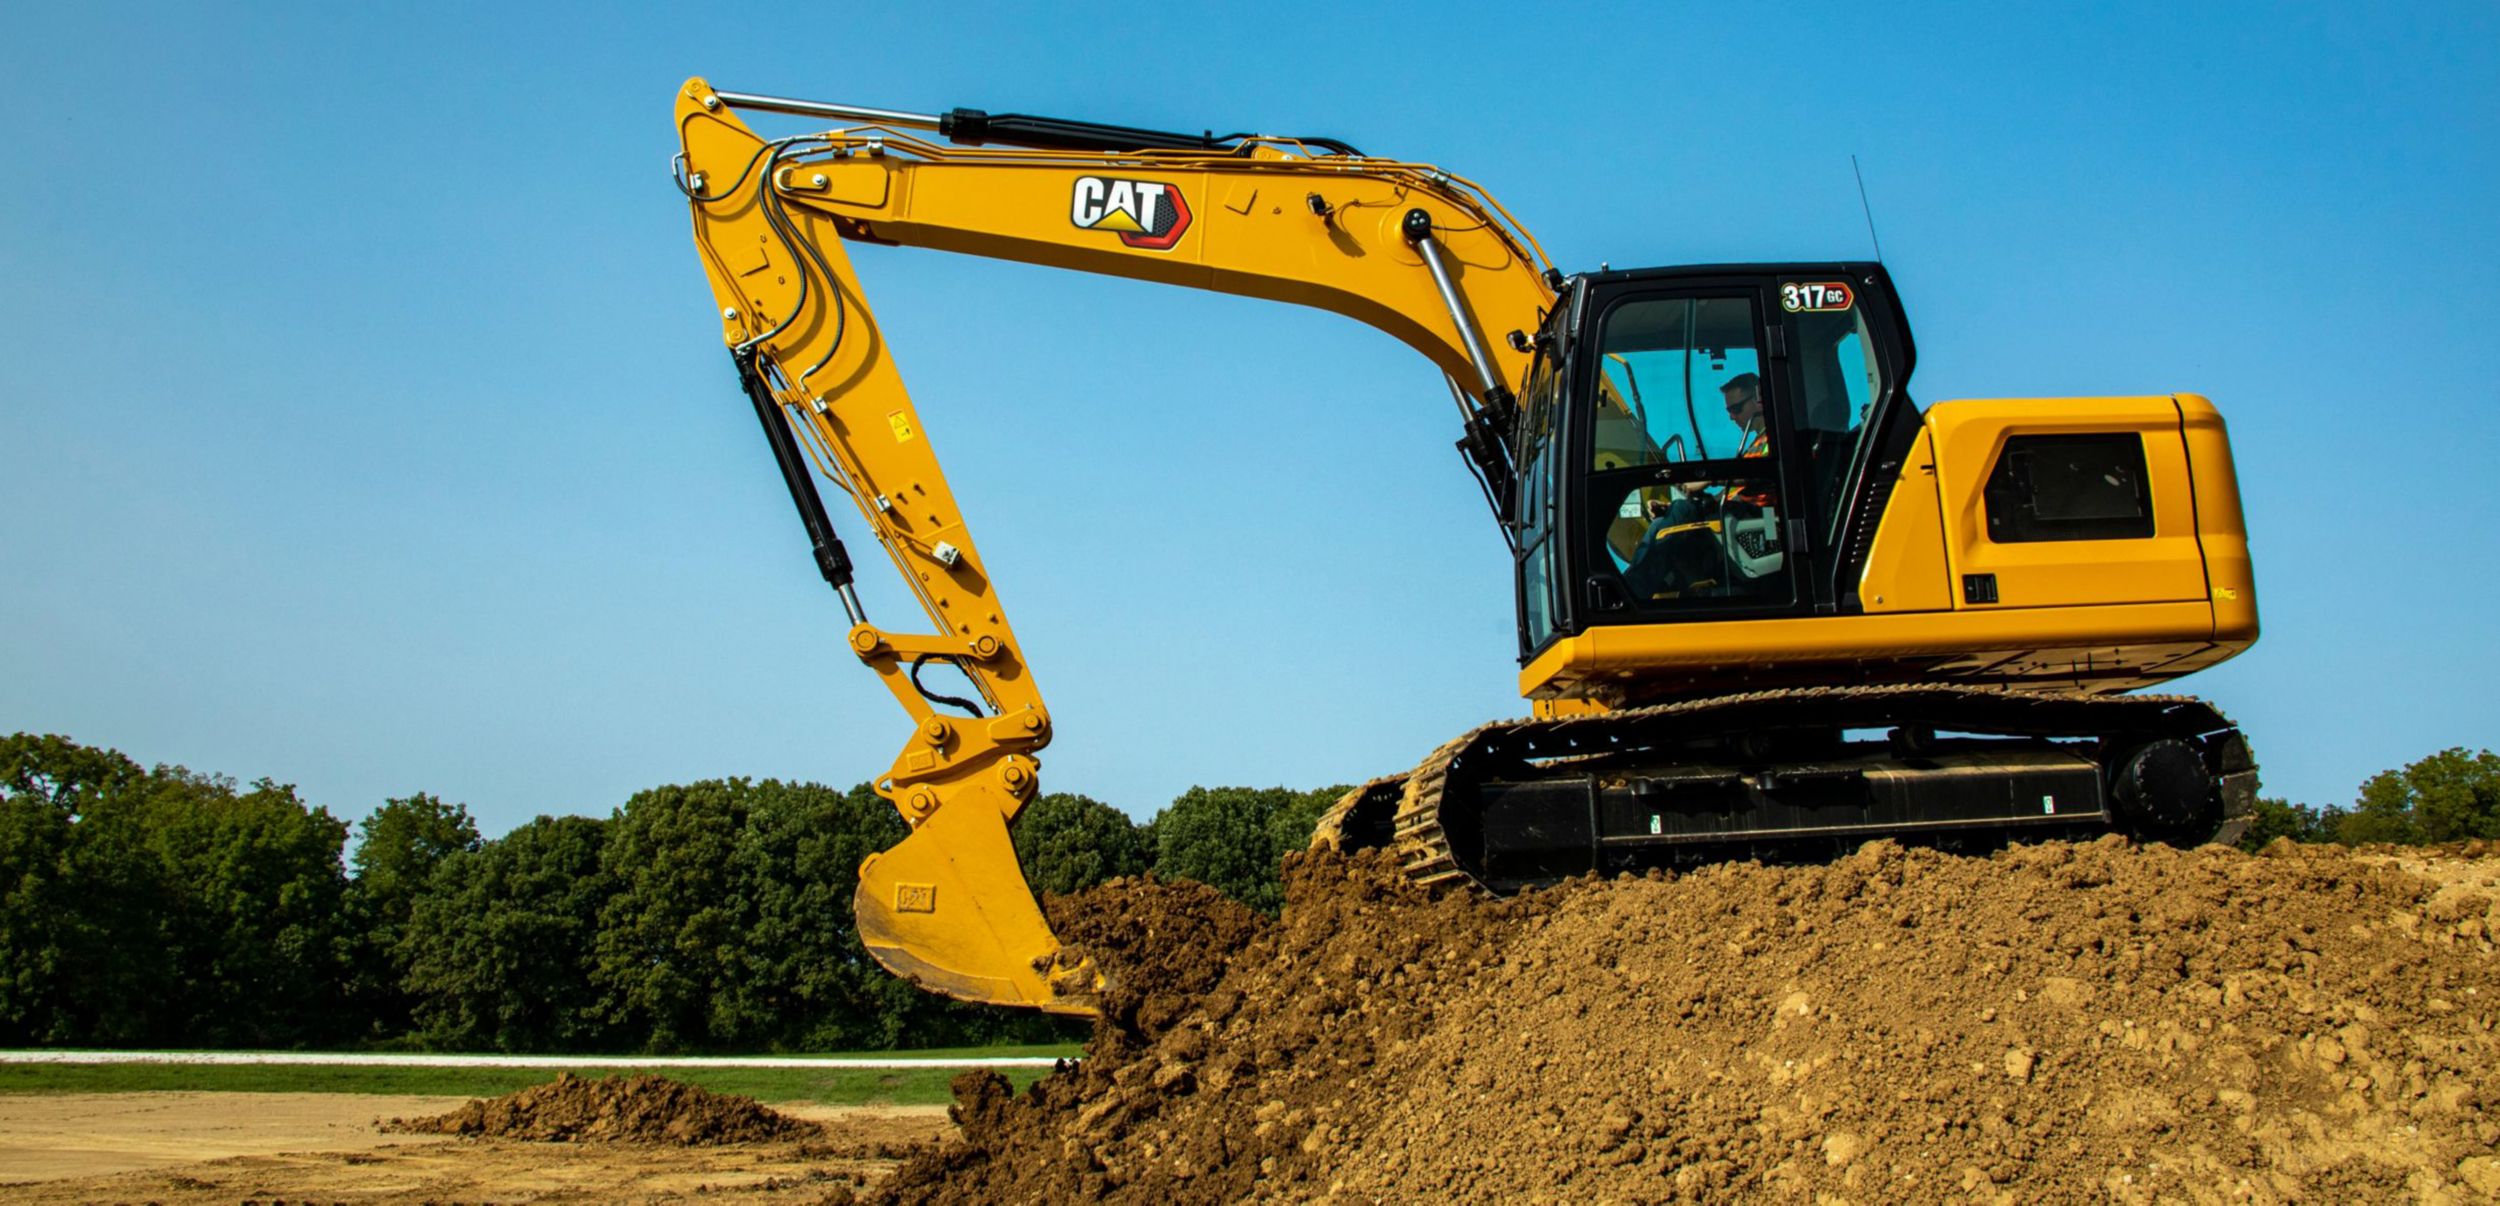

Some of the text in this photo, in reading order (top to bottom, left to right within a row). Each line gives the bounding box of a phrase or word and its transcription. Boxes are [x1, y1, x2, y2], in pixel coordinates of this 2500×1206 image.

[1072, 177, 1165, 233] CAT
[1784, 285, 1844, 309] 317 GC
